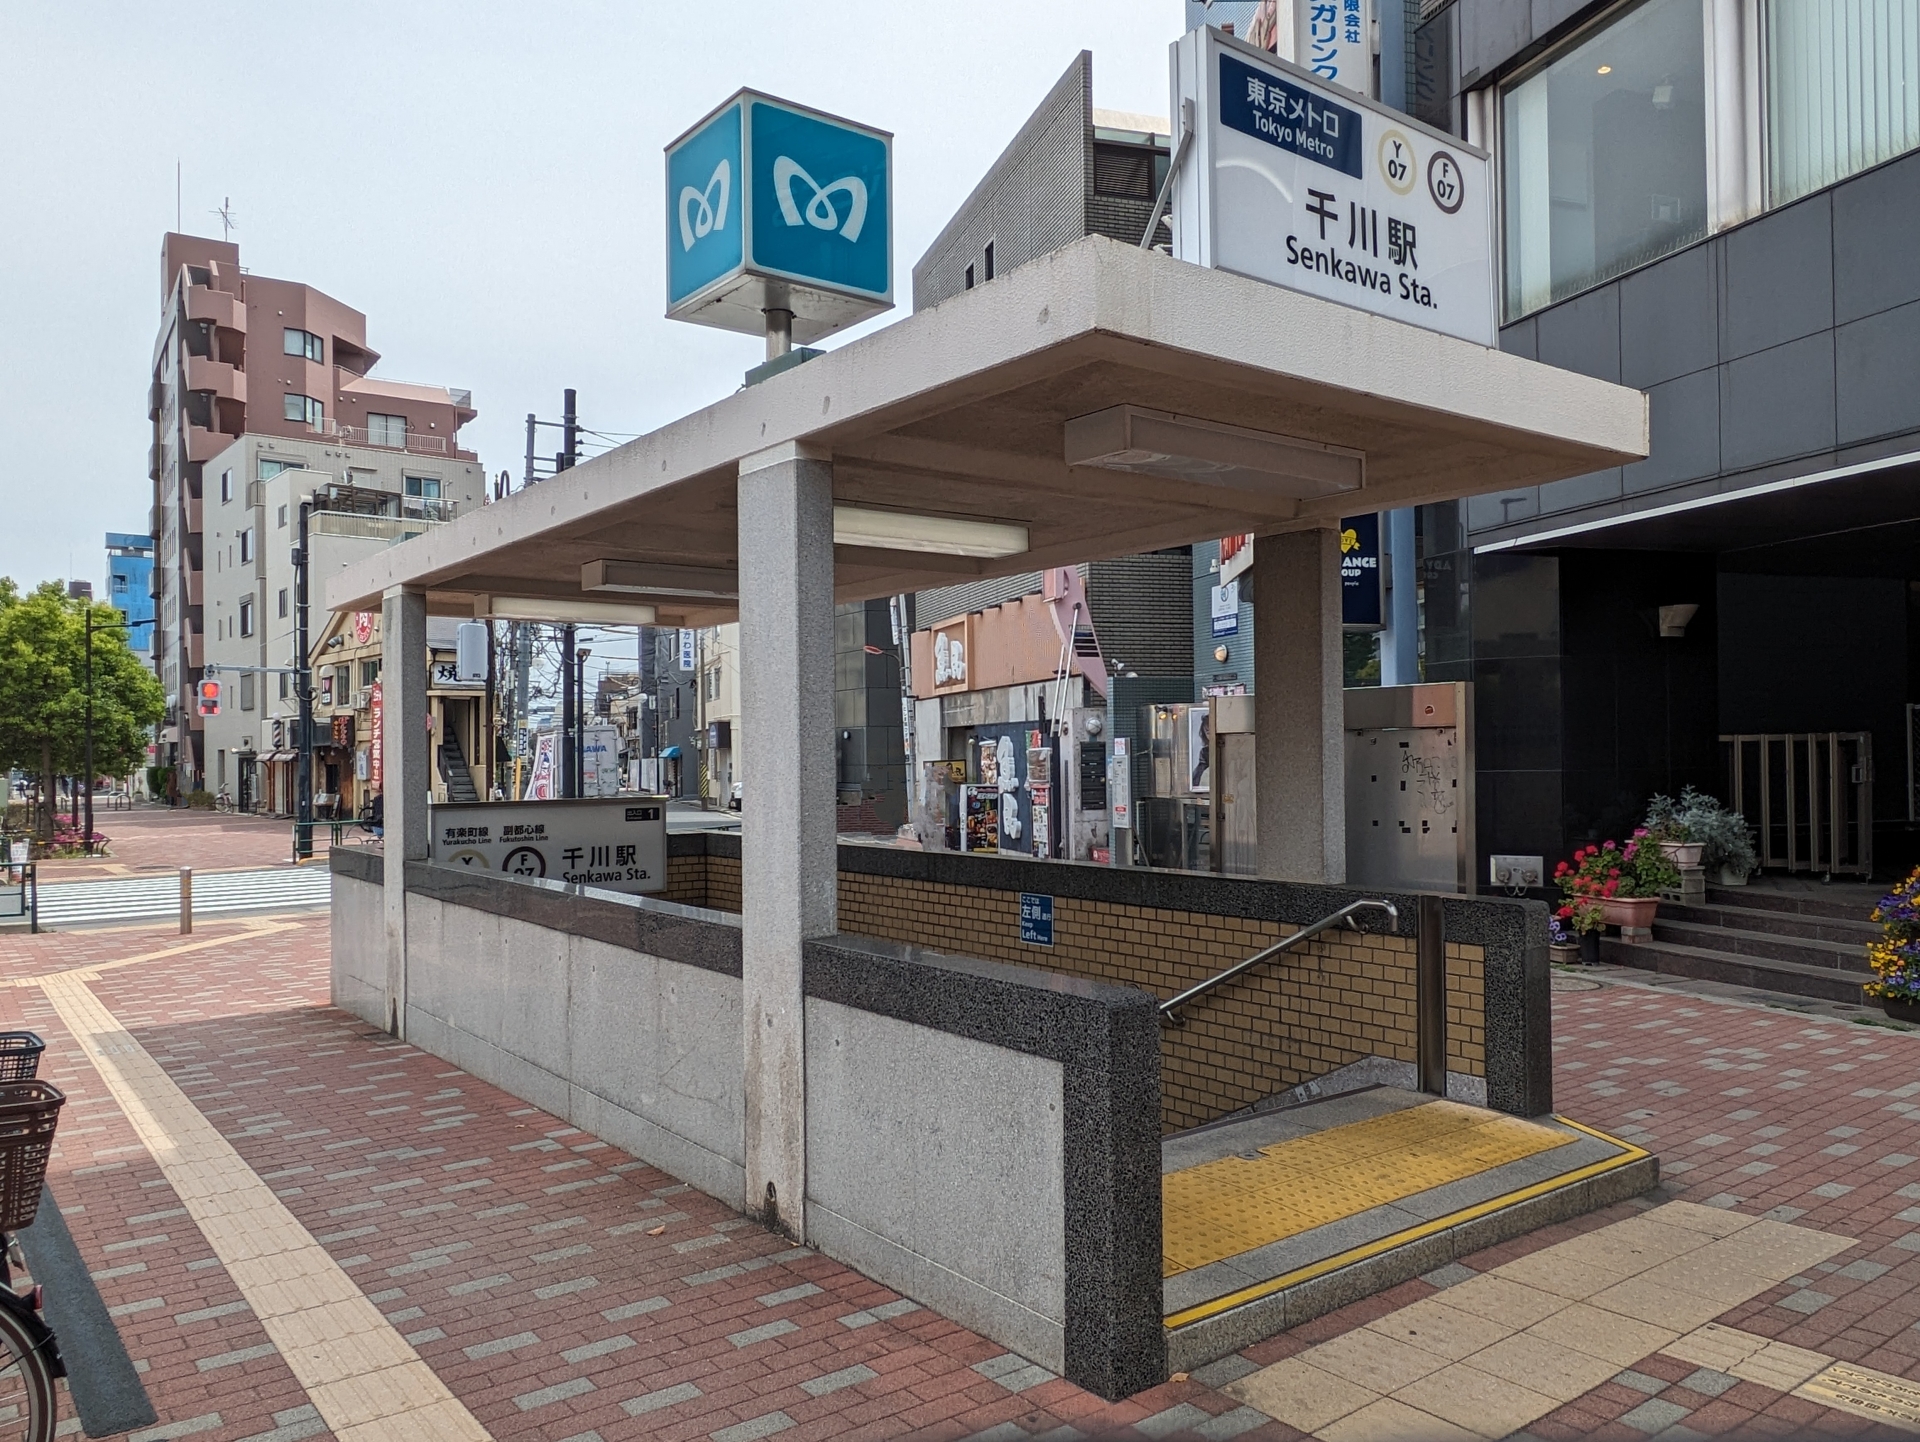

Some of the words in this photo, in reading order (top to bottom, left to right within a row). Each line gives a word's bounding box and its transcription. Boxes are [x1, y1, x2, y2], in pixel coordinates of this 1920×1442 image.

[1310, 0, 1338, 80] ガリンク
[1246, 76, 1339, 138] 東京メトロ
[1252, 109, 1292, 143] Tokyo
[1296, 130, 1334, 159] Metro
[1393, 140, 1402, 158] Y
[1388, 159, 1407, 181] 07
[1442, 162, 1449, 178] F
[1437, 180, 1455, 200] 07
[1305, 187, 1418, 270] 千川駅
[1286, 235, 1391, 295] Senkawa
[1399, 273, 1438, 309] Sta.
[1342, 556, 1377, 568] ANCE
[1341, 569, 1362, 577] OUP
[438, 664, 463, 682] 焼
[583, 745, 607, 753] AWA
[648, 808, 654, 819] 1
[445, 826, 489, 839] 有楽町線
[503, 824, 545, 836] 副都心線
[442, 838, 477, 846] Yurakucho
[521, 854, 528, 866] F
[562, 845, 636, 869] 千川駅
[563, 869, 622, 884] Senkawa
[626, 868, 651, 880] Sta.
[1022, 929, 1037, 940] Left
